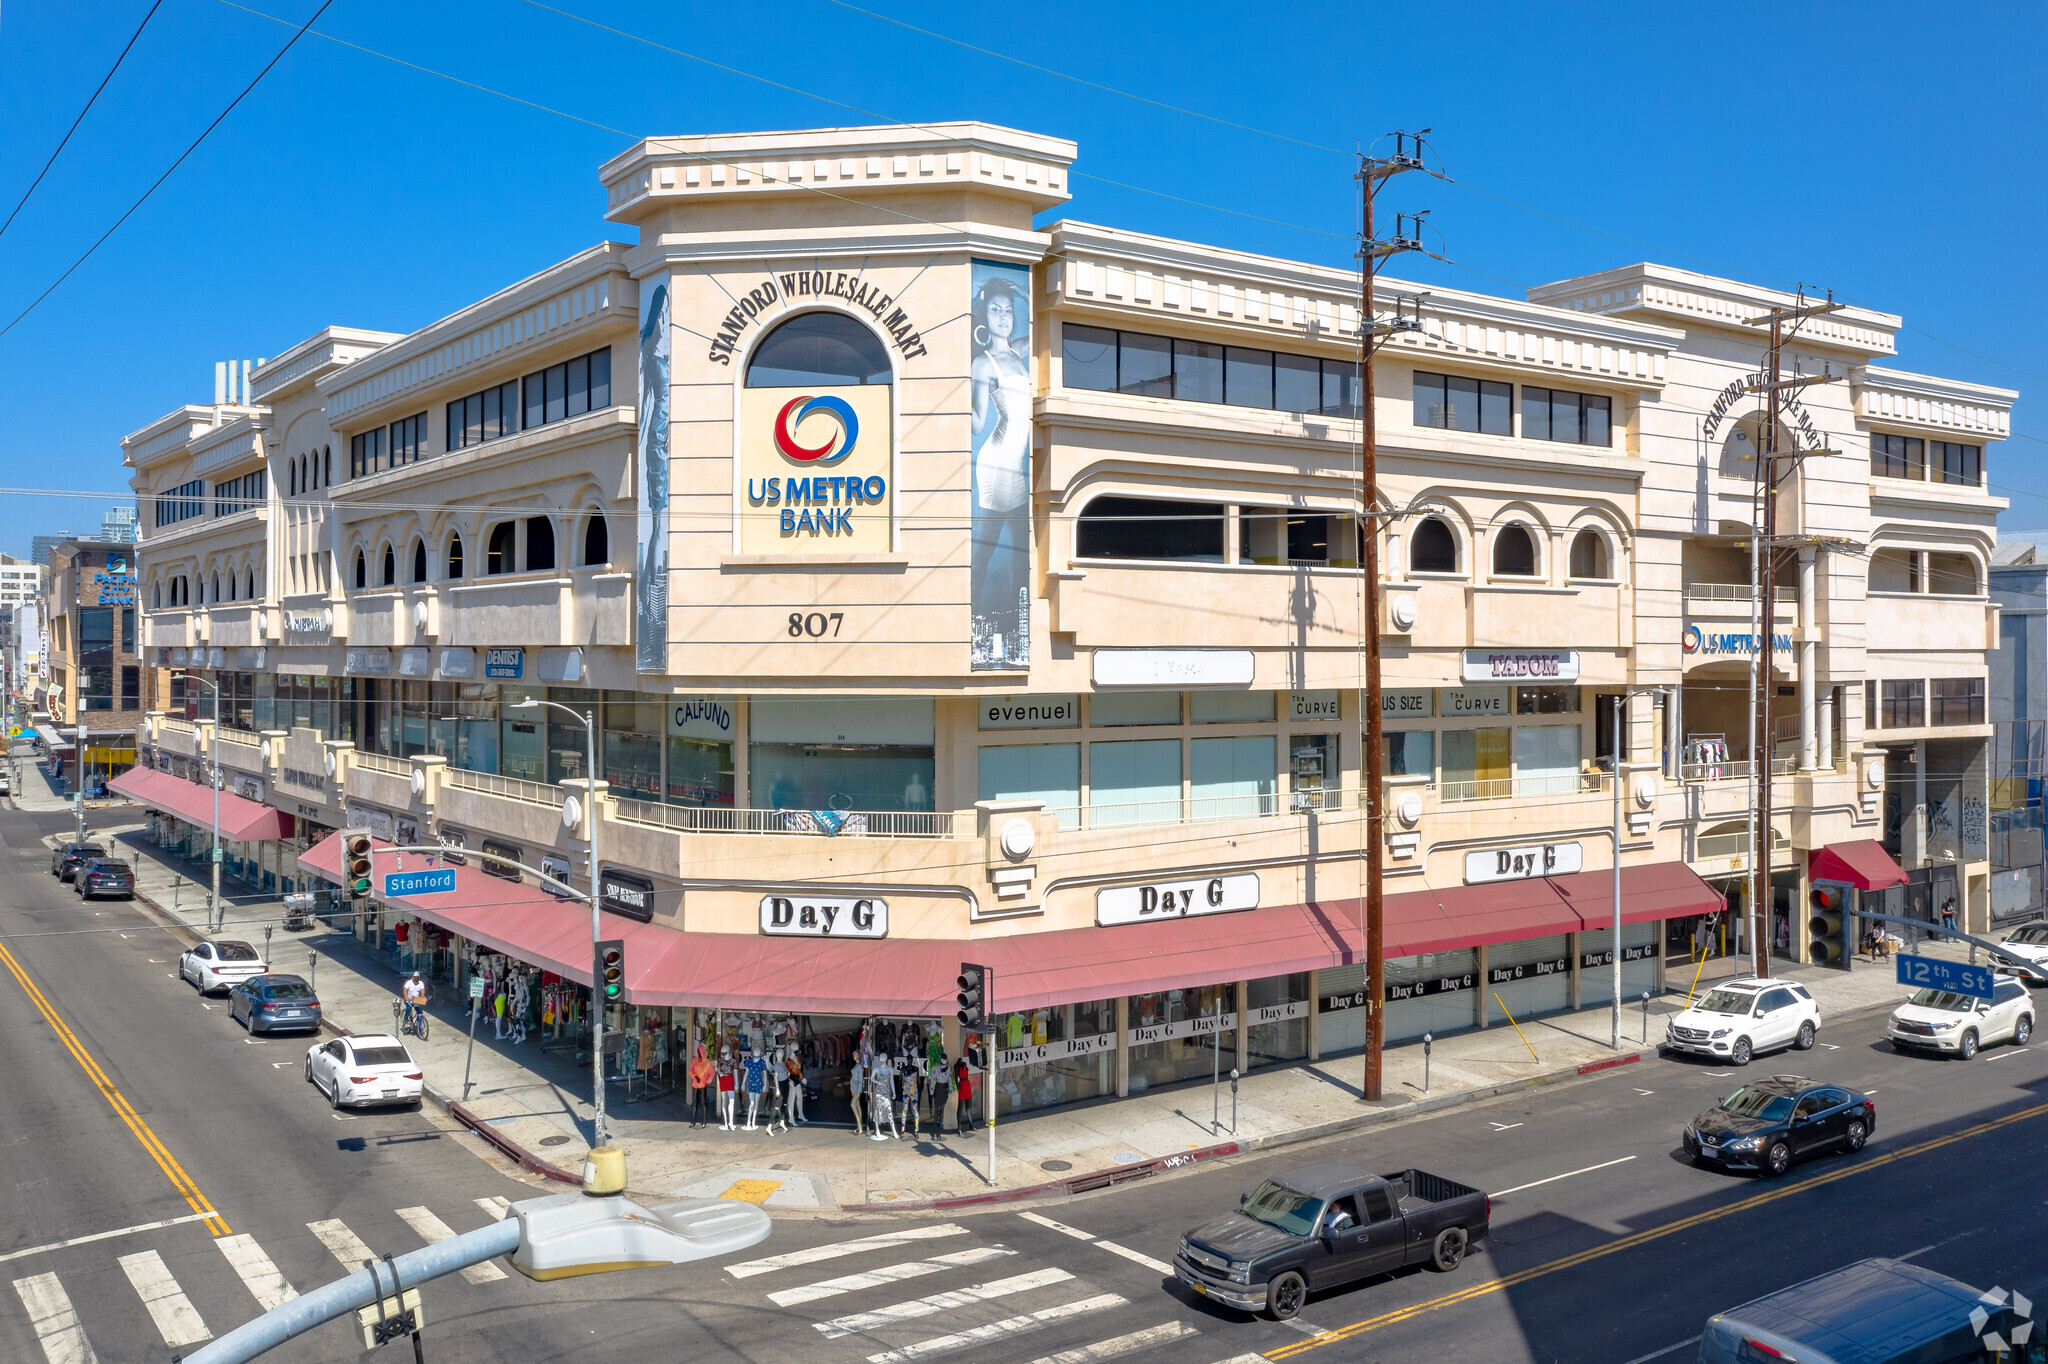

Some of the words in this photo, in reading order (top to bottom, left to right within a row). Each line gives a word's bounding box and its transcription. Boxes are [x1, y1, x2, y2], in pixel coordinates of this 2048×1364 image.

[709, 281, 778, 366] STANFORD
[780, 271, 893, 318] WHOLESALE
[883, 307, 928, 361] MART
[1798, 408, 1822, 450] MART
[749, 478, 781, 501] US
[786, 475, 886, 501] METRO
[780, 508, 853, 532] BANK
[102, 584, 130, 595] CITY
[98, 594, 133, 605] BANK
[788, 612, 844, 638] 807
[1702, 633, 1718, 651] US
[1772, 633, 1793, 650] ANK
[486, 650, 521, 666] DENTIST
[1489, 655, 1560, 677] TABOM
[1400, 695, 1423, 710] SIZE
[1450, 692, 1465, 700] The
[1455, 698, 1500, 711] CURVE
[675, 699, 730, 731] CALFUND
[988, 702, 1072, 721] evenuel
[1296, 701, 1336, 715] CURVE
[1496, 851, 1536, 876] Day
[1543, 844, 1556, 869] G
[391, 875, 451, 891] Stanford
[1139, 886, 1194, 916] Day
[1207, 877, 1224, 906] G
[770, 897, 840, 934] Day
[852, 899, 875, 931] G
[1585, 954, 1603, 966] Day
[1605, 951, 1612, 963] G
[1626, 947, 1642, 959] Day
[1644, 945, 1651, 956] G
[1493, 969, 1513, 981] Day
[1515, 966, 1523, 978] G
[1537, 962, 1554, 974] Day
[1557, 959, 1565, 970] G
[1441, 978, 1461, 990] Day
[1463, 974, 1472, 987] G
[1904, 960, 1950, 983] 12th
[1961, 971, 1986, 991] St
[1392, 986, 1413, 999] Day
[1415, 982, 1424, 995] G
[1330, 996, 1352, 1009] Day
[1354, 992, 1364, 1005] G
[1260, 1008, 1283, 1020] Day
[1287, 1004, 1295, 1016] G
[1135, 1028, 1160, 1041] Day
[1165, 1023, 1174, 1036] G
[1192, 1019, 1216, 1032] Day
[1220, 1015, 1229, 1027] G
[1067, 1040, 1093, 1053] Day
[1099, 1034, 1108, 1048] G
[1004, 1050, 1032, 1064] Day
[1037, 1045, 1047, 1058] G
